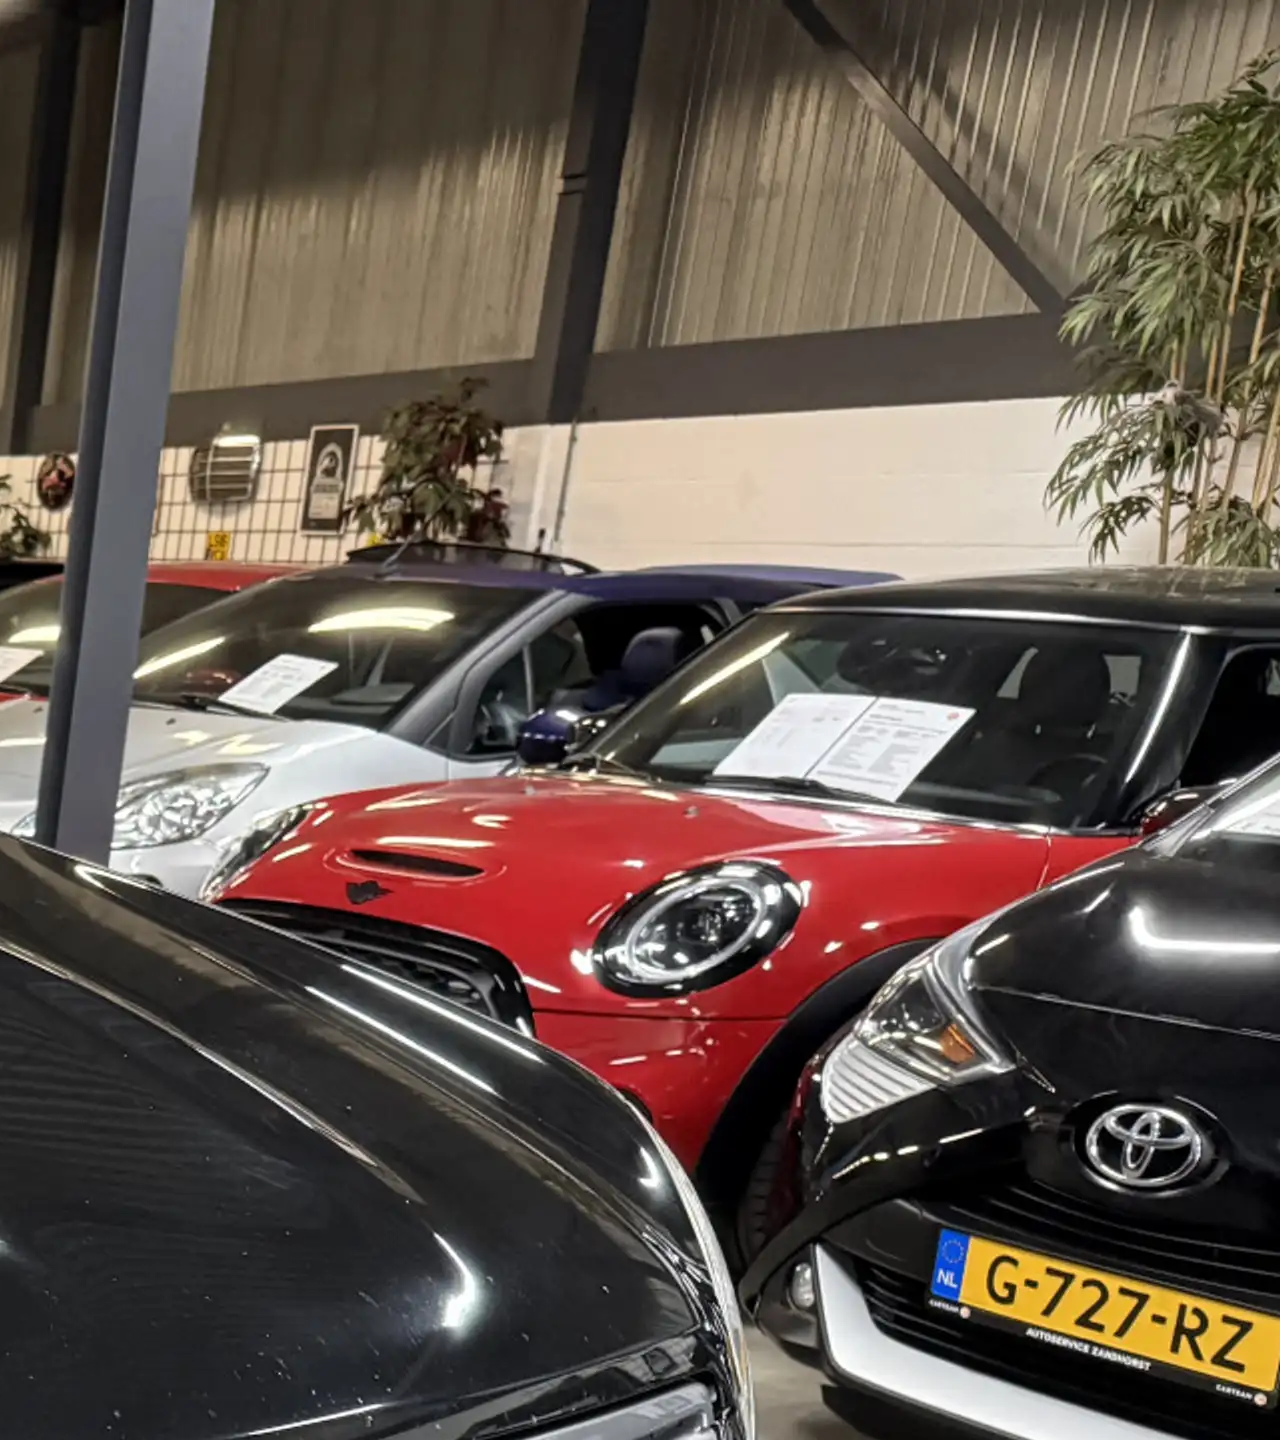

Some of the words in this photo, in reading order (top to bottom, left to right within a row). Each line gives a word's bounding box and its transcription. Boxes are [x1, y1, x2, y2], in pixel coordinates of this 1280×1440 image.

[936, 1267, 959, 1288] NL
[986, 1254, 1254, 1373] G-727-RZ
[1025, 1327, 1090, 1353] AUTOSERVICE
